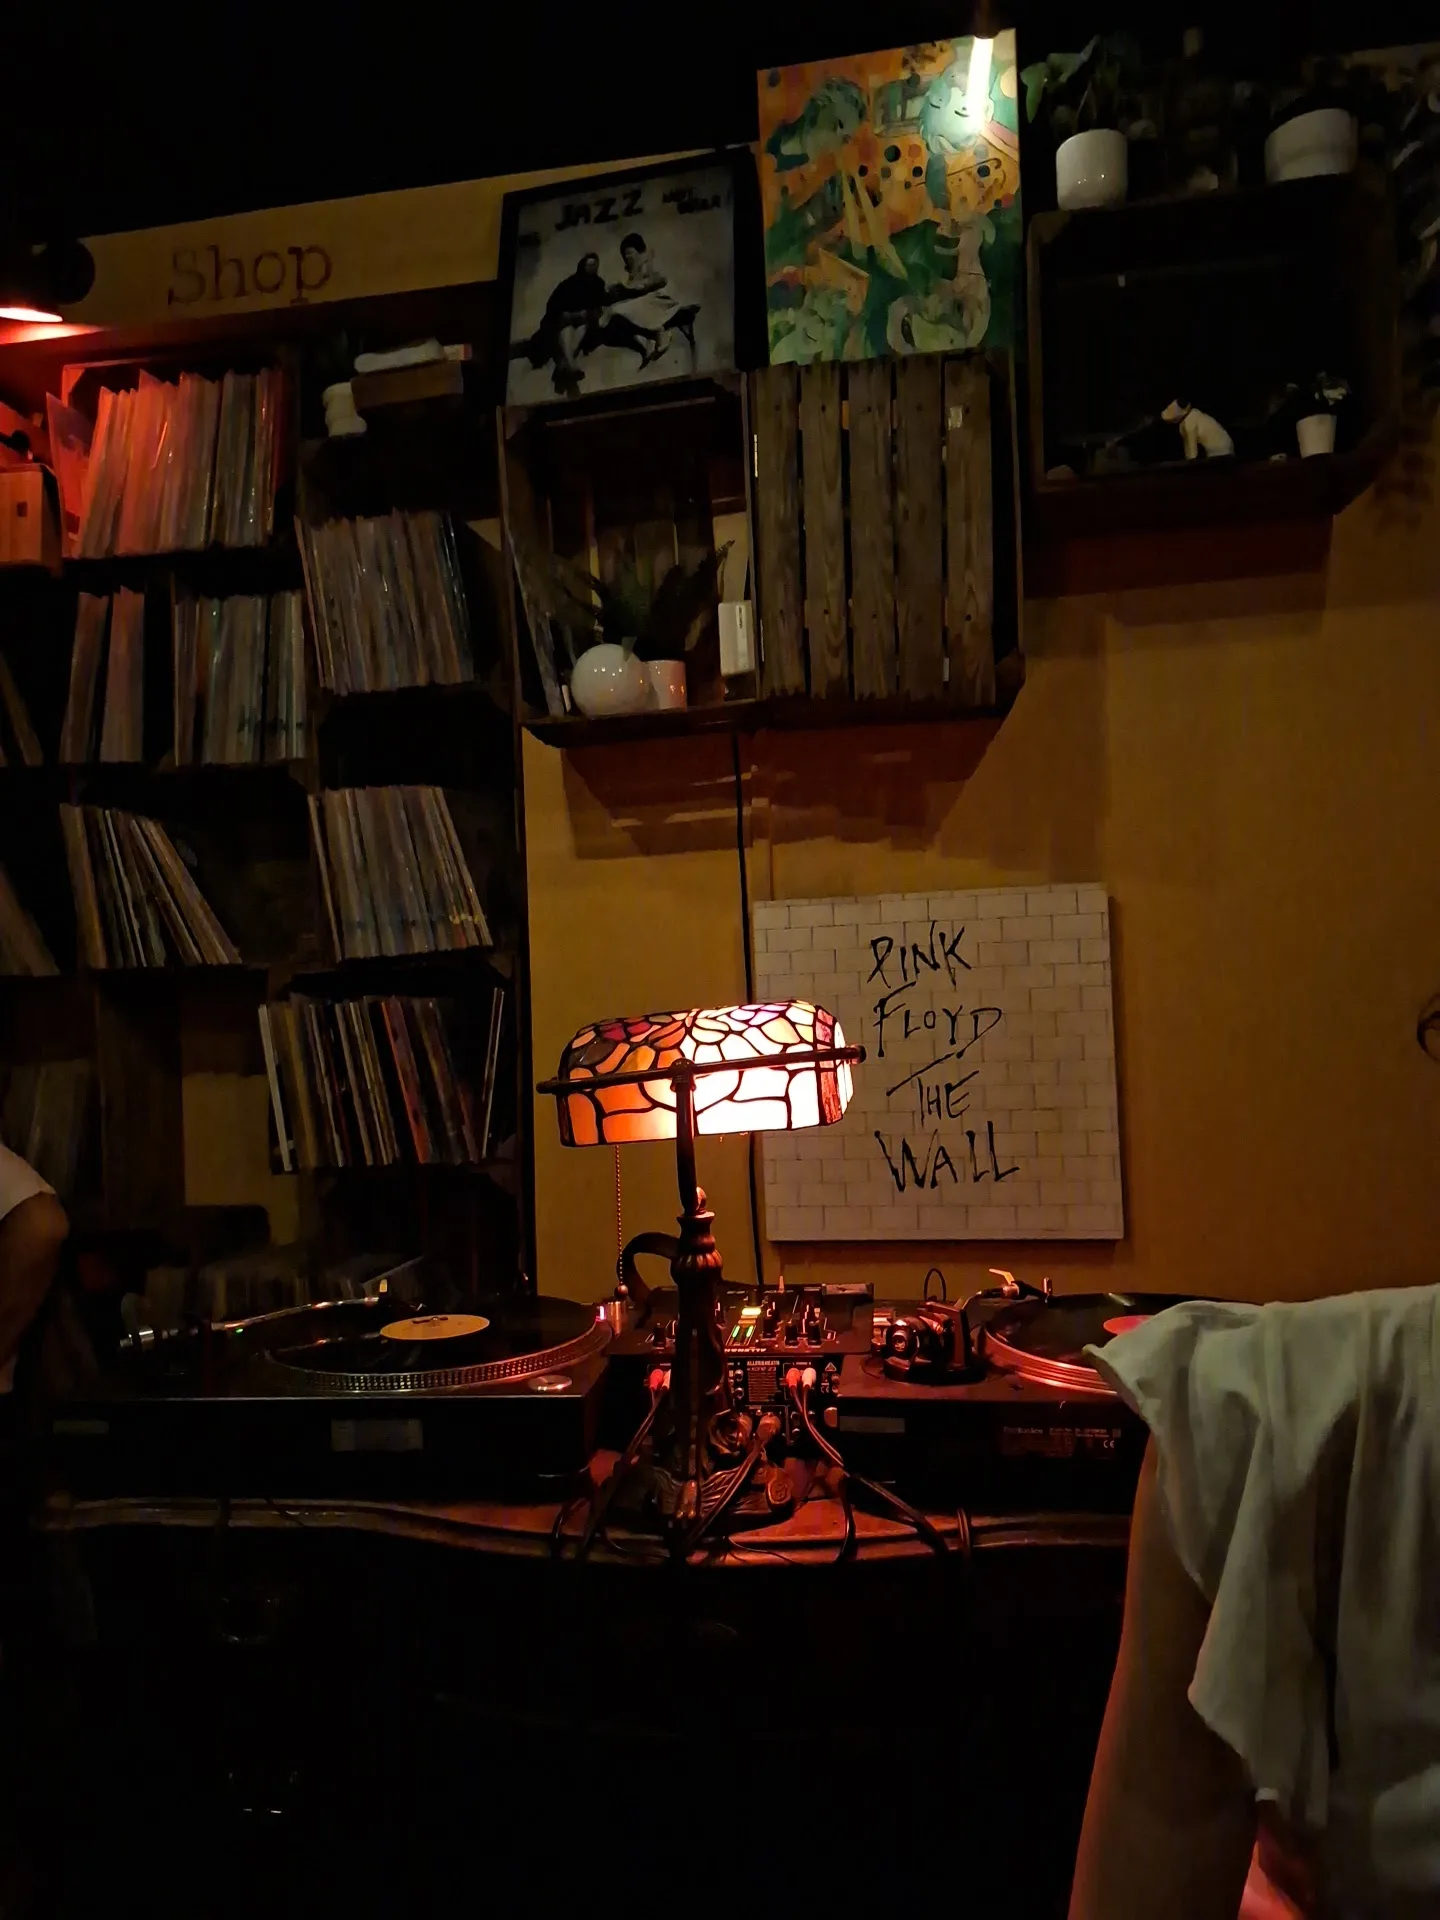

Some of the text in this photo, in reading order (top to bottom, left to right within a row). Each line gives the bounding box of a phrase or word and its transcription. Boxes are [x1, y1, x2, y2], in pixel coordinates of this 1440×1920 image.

[555, 190, 643, 230] JAZZ
[168, 244, 332, 305] Shop
[867, 920, 971, 989] PINK
[873, 981, 1002, 1058] FLOYD
[886, 1052, 979, 1127] THE
[874, 1120, 1020, 1191] WALL
